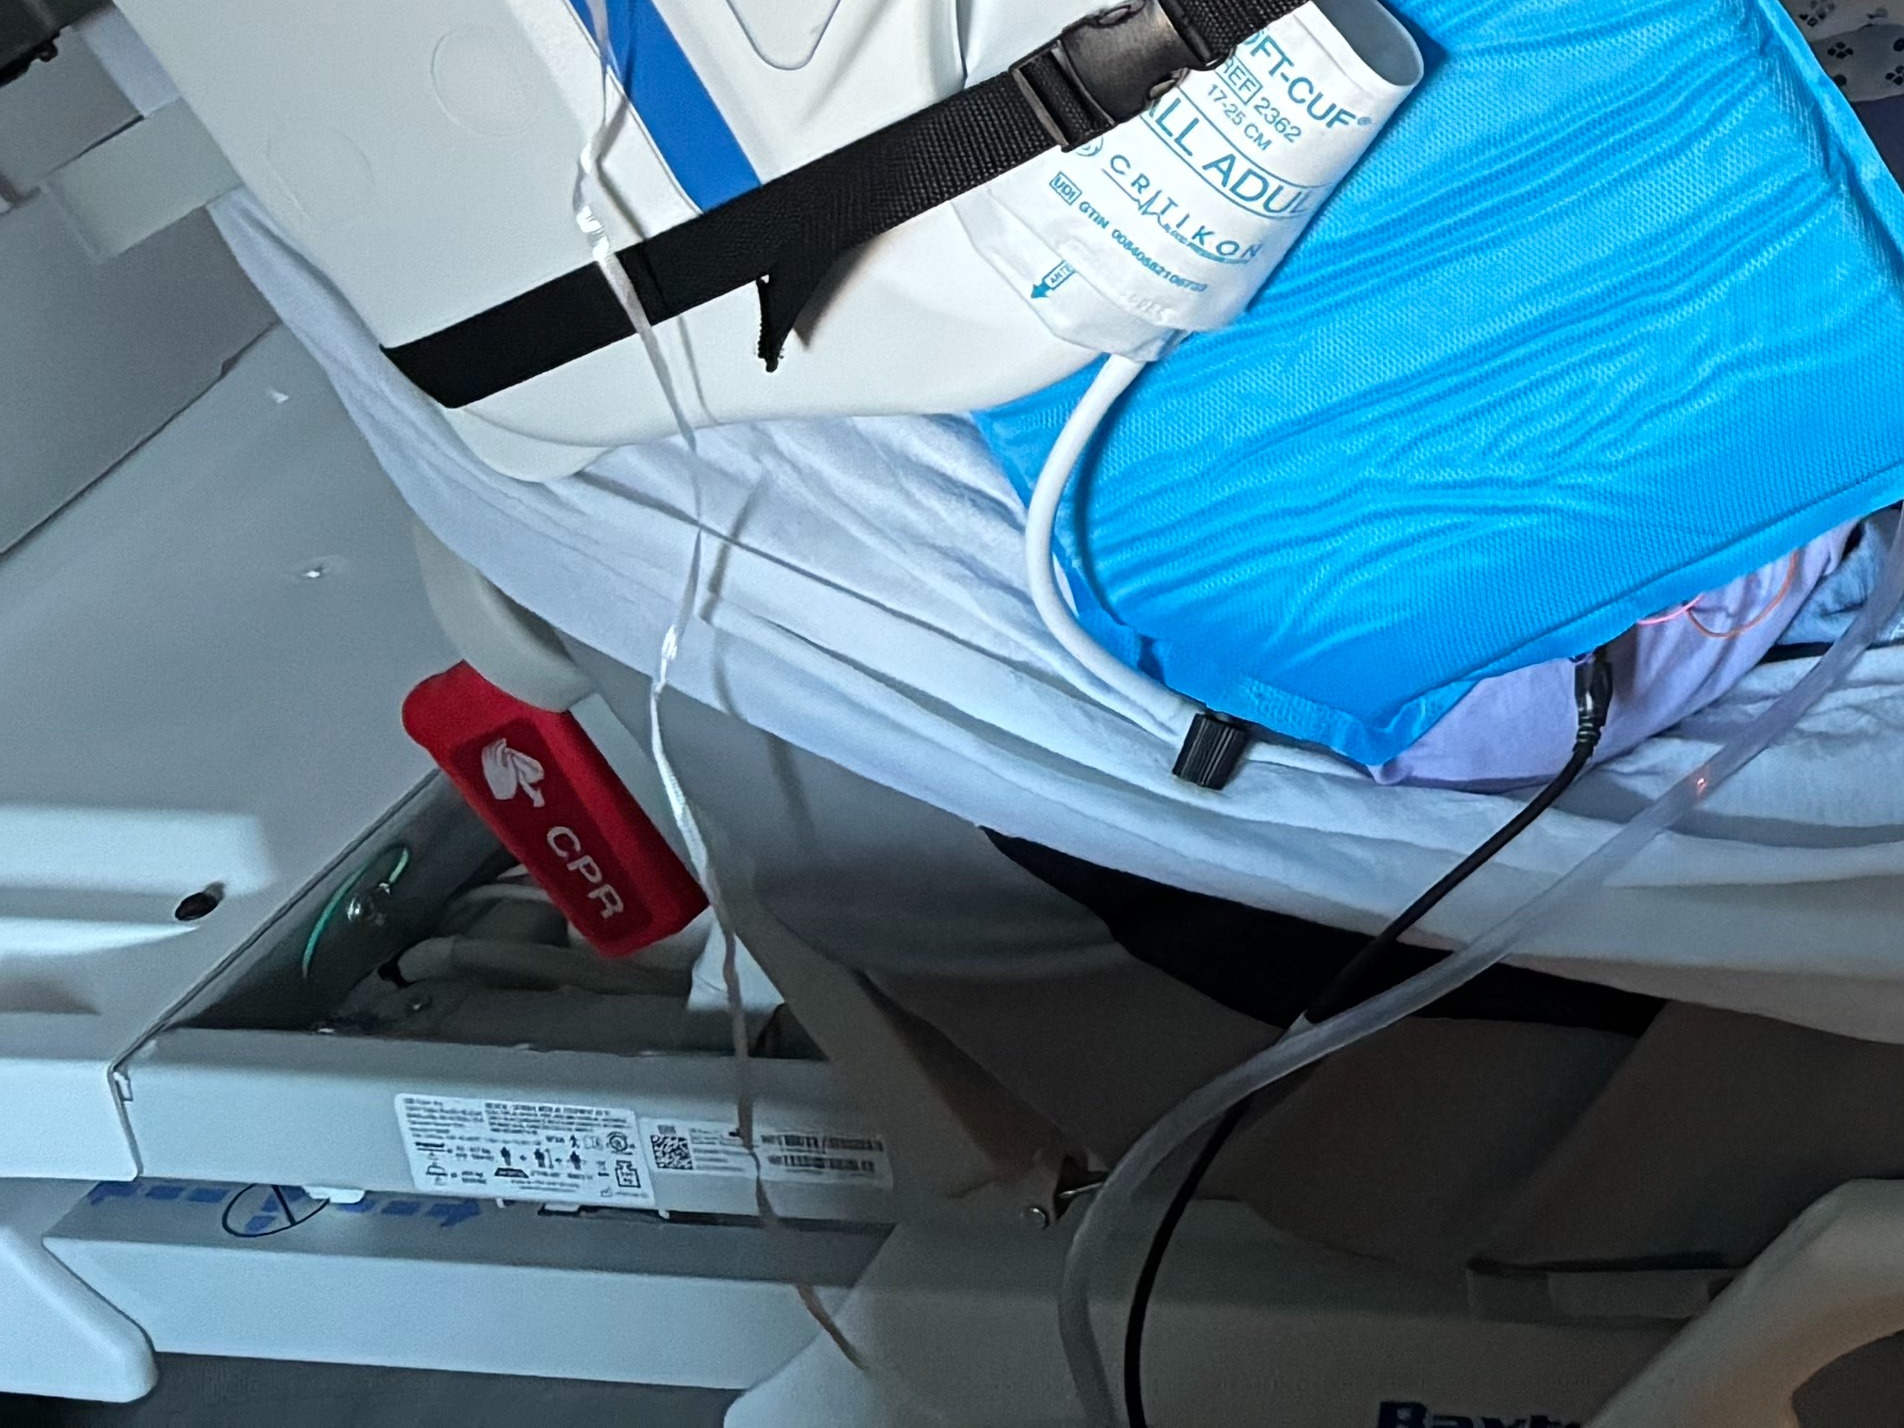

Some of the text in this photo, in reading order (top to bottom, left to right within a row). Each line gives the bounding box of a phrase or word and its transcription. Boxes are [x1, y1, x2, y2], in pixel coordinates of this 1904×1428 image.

[1207, 83, 1273, 152] 17-25 CM
[1220, 56, 1302, 143] REF 2362
[1243, 29, 1356, 129] FT-CUF
[1053, 176, 1077, 200] UDI
[1078, 201, 1110, 230] GTIN
[1109, 154, 1265, 262] CRITIKON
[1202, 153, 1311, 215] ADUL
[546, 826, 625, 921] CPR
